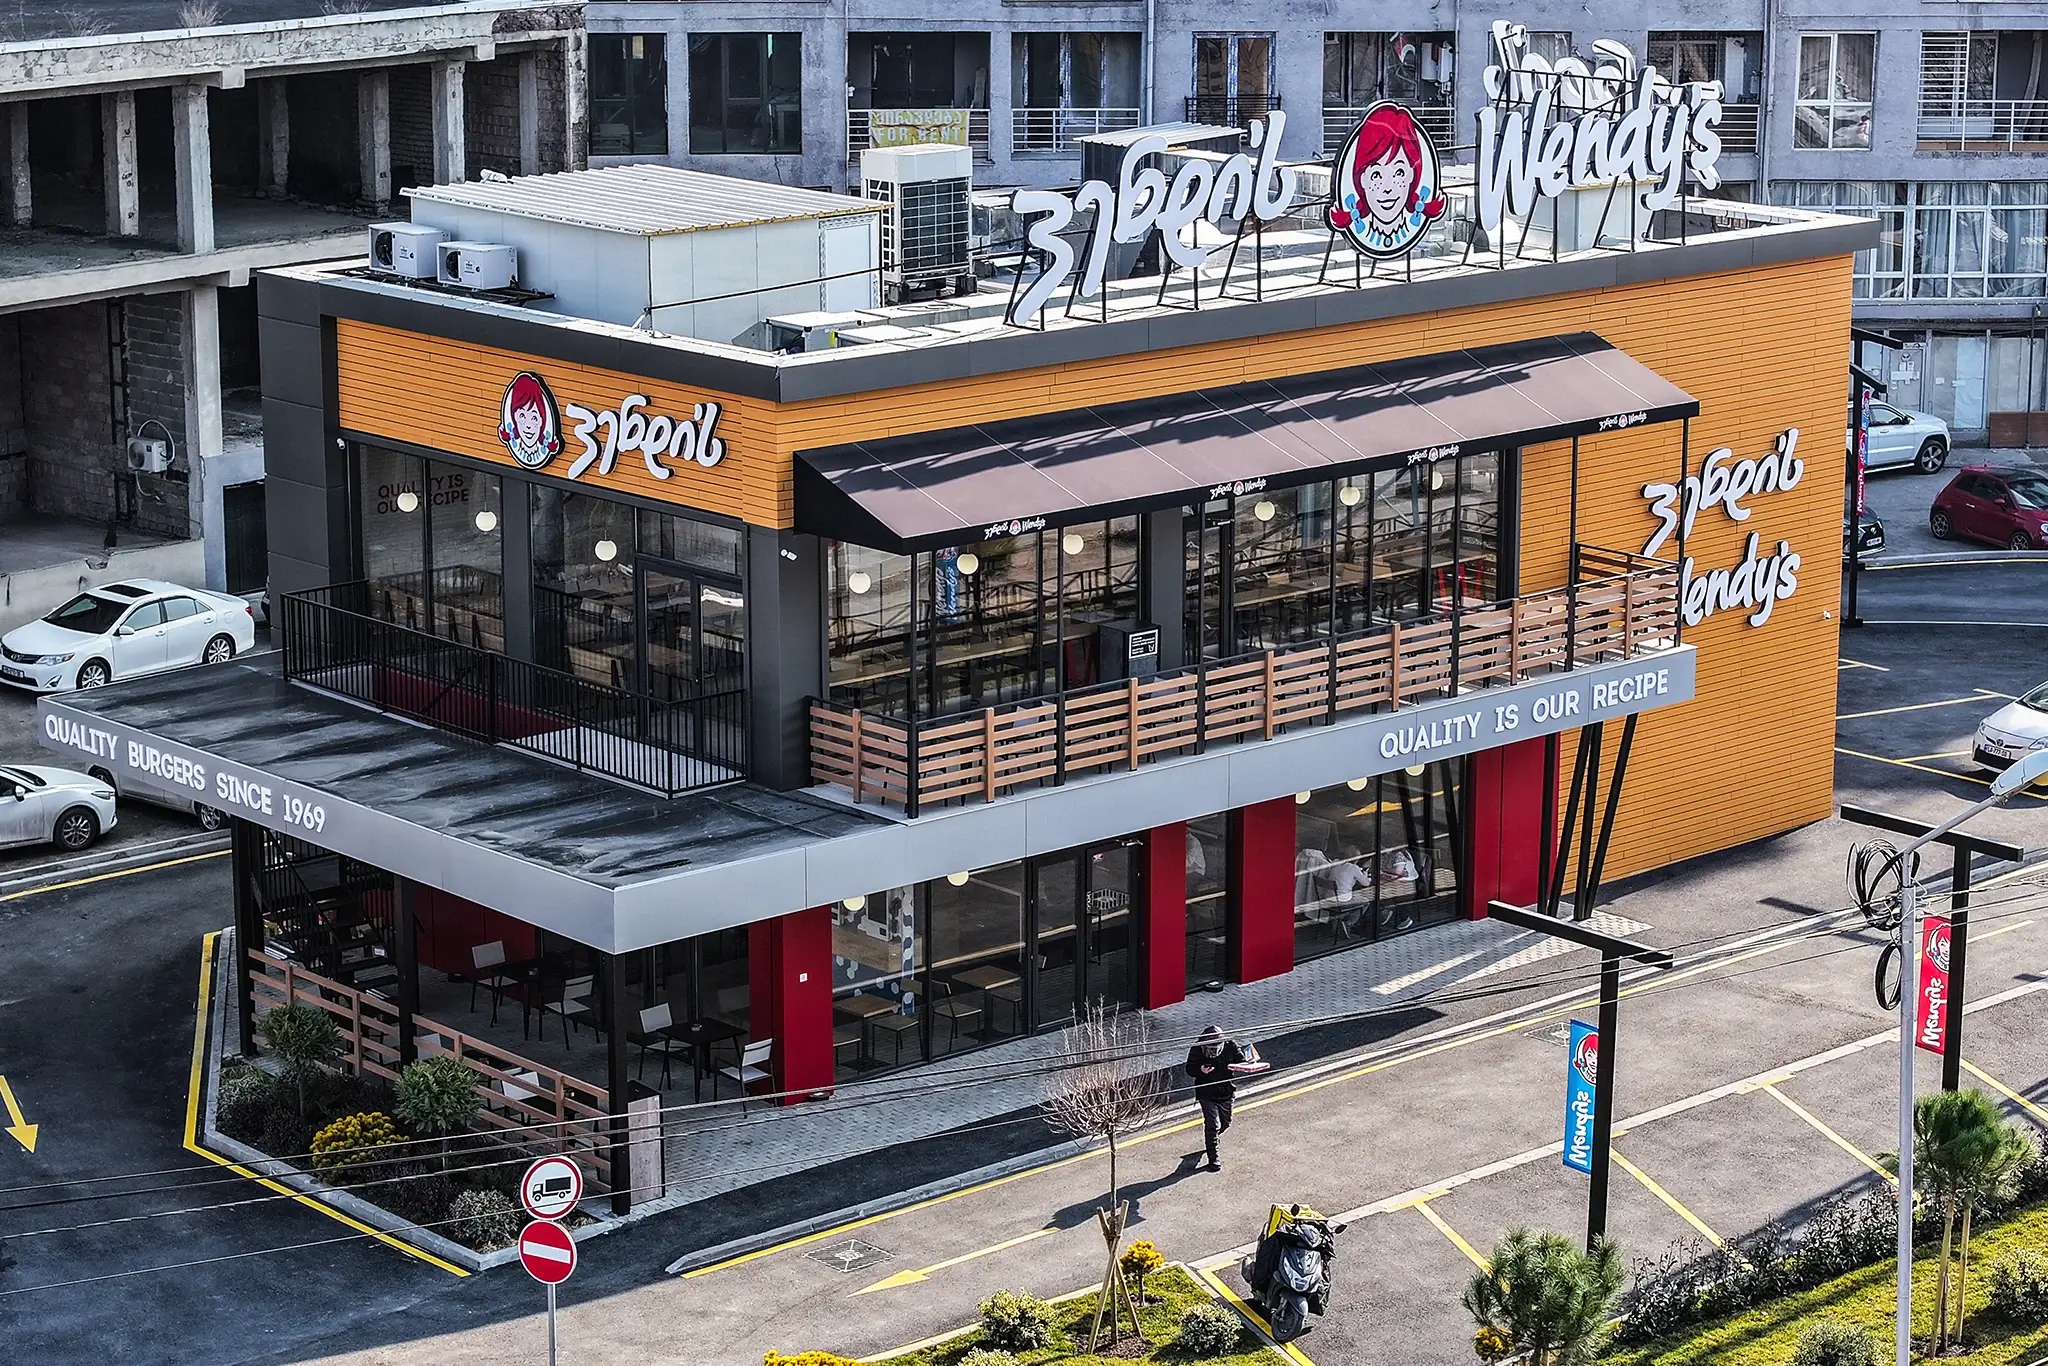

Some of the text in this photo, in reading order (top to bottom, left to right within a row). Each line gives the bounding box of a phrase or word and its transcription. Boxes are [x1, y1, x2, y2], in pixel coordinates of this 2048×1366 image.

[877, 126, 908, 142] FOR
[1475, 65, 1723, 231] Wendy's
[1010, 110, 1297, 329] ვენდი'ს
[448, 473, 464, 488] IS
[566, 394, 726, 480] ვენდი'ს
[1683, 531, 1801, 628] endy's
[1380, 668, 1670, 759] QUALITY IS OUR RECIPE
[44, 713, 327, 834] QUALITY BURGERS SINCE 1969
